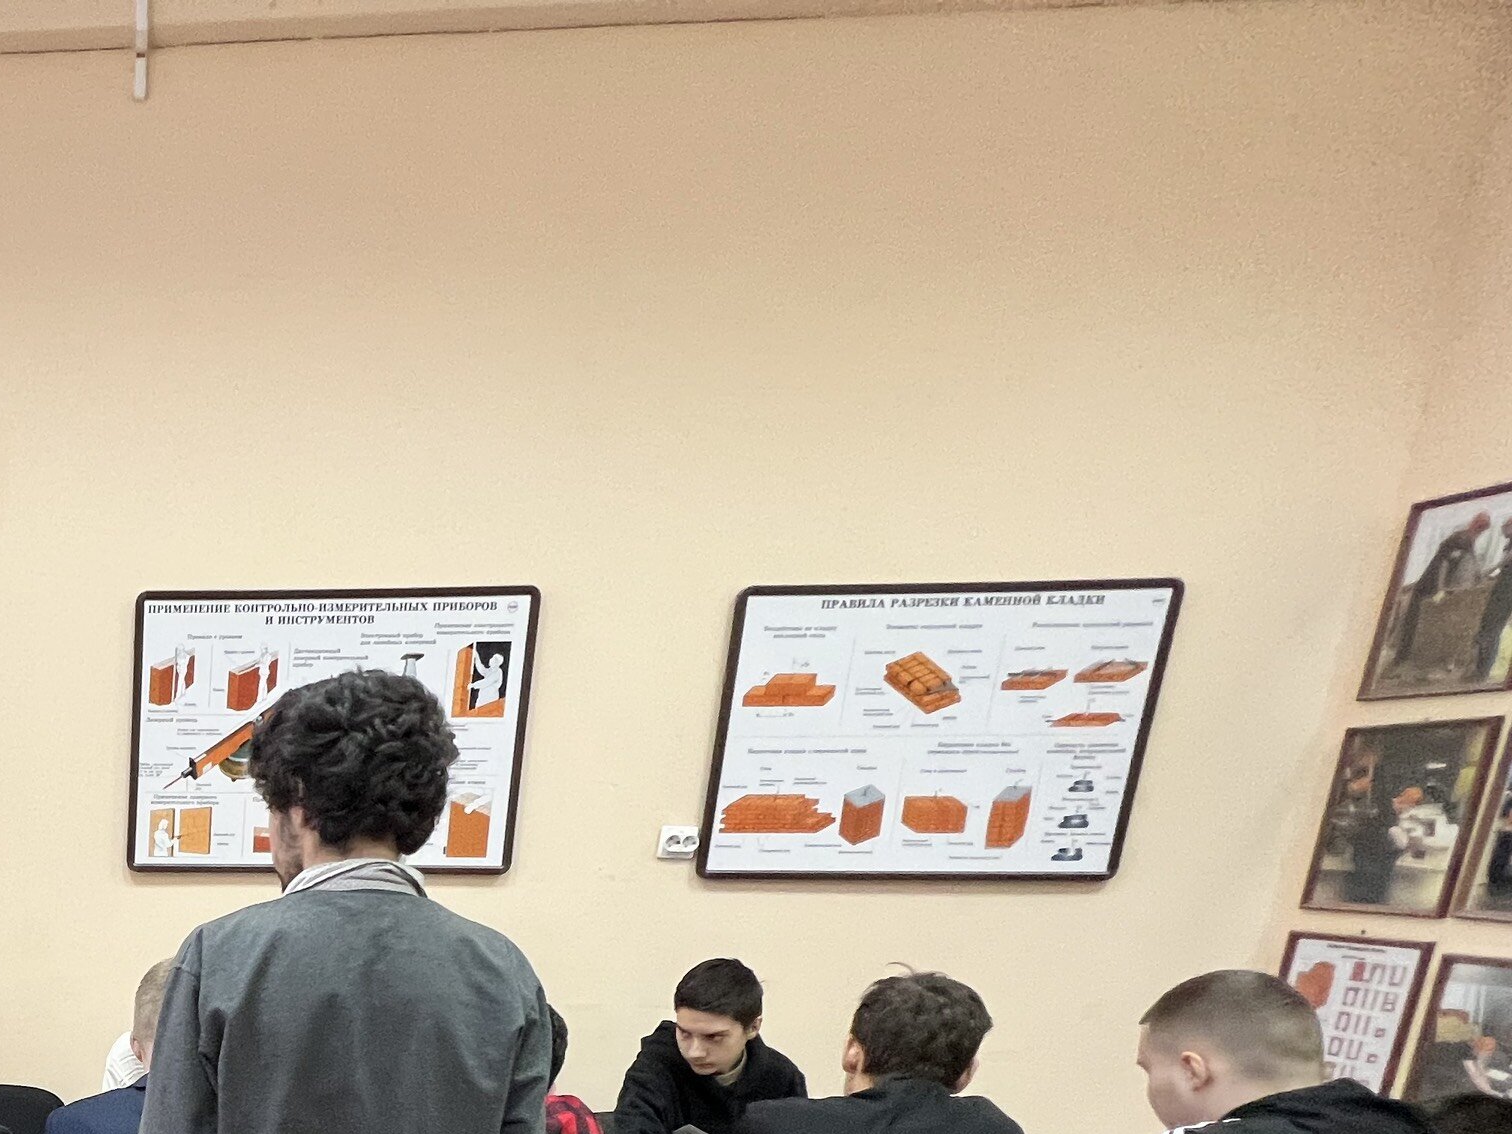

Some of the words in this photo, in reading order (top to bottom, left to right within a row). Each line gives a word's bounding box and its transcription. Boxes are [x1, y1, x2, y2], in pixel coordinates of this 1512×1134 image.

[821, 599, 885, 609] ПРАВИЛА
[890, 597, 960, 607] РАЗРЕЗКИ
[963, 594, 1041, 606] КАМЕННОЙ
[1046, 595, 1106, 606] КЛАДКИ
[148, 604, 230, 613] ПРИМЕНЕНИЕ
[234, 602, 428, 614] КОНТРОЛЬНО-ИЗМЕРИТЕЛЬНЫХ
[433, 602, 497, 611] ПРИБОРОВ
[265, 616, 273, 625] И
[278, 615, 374, 624] ИНСТРУМЕНТОВ
